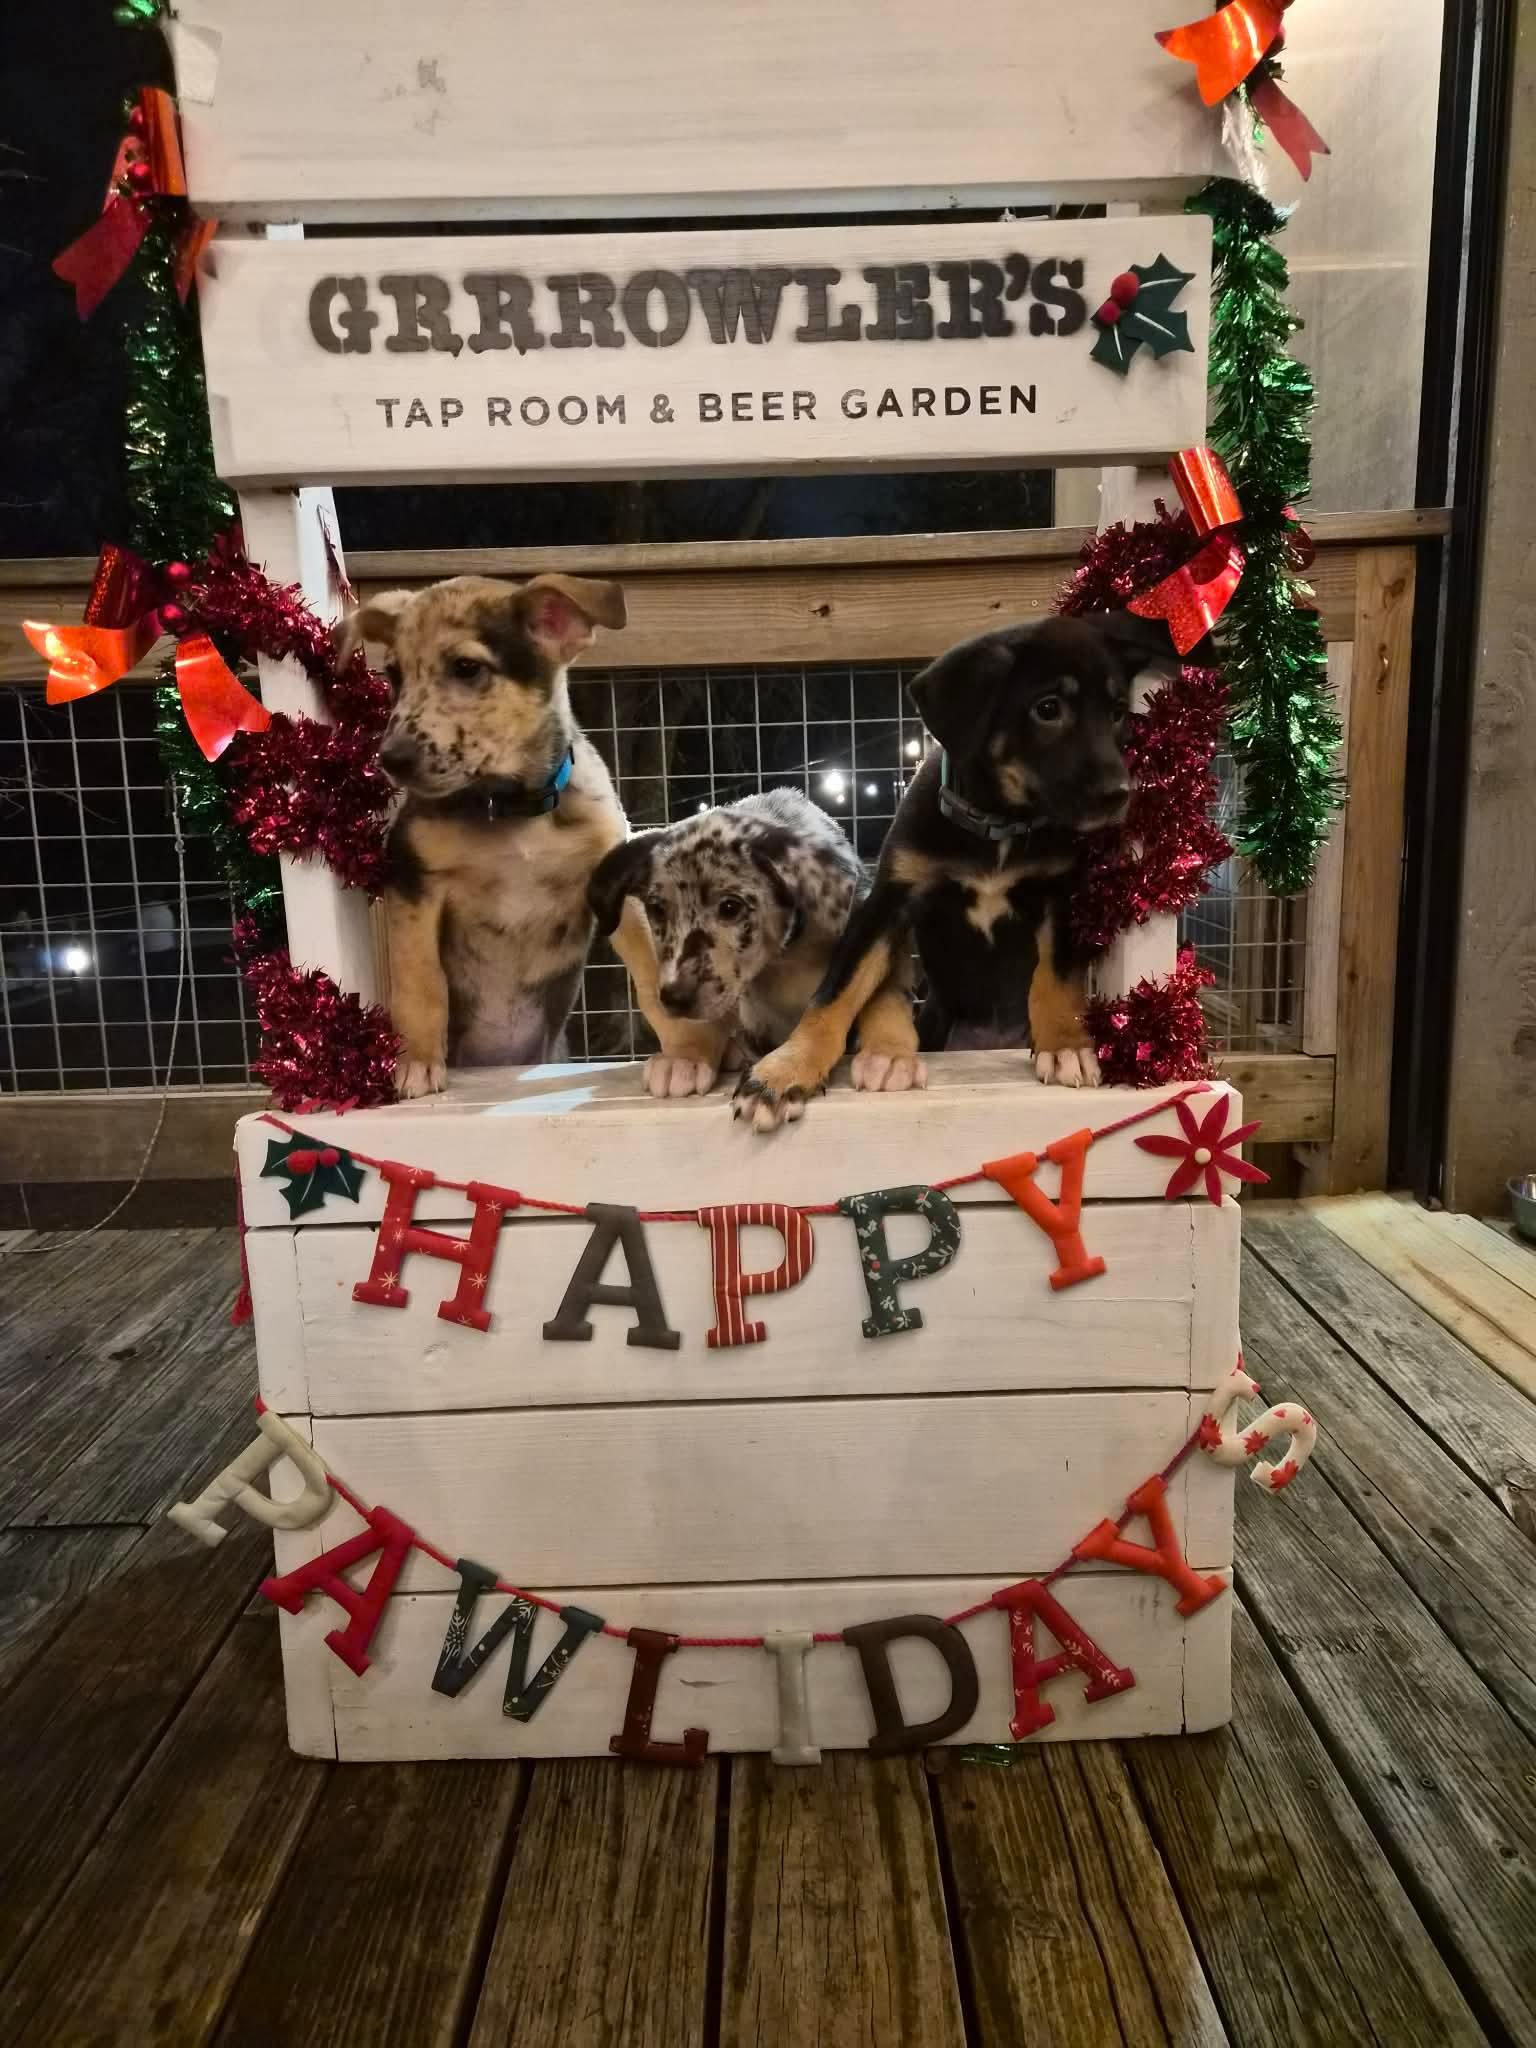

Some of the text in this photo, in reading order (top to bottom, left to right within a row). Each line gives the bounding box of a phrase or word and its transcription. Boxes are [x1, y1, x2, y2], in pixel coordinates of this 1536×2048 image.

[308, 252, 1088, 356] GRRROWLER'S
[376, 384, 1038, 429] TAP ROOM & BEER GARDEN
[351, 1127, 1107, 1350] HAPPY
[166, 1368, 1317, 1767] PAWLIDAYS
